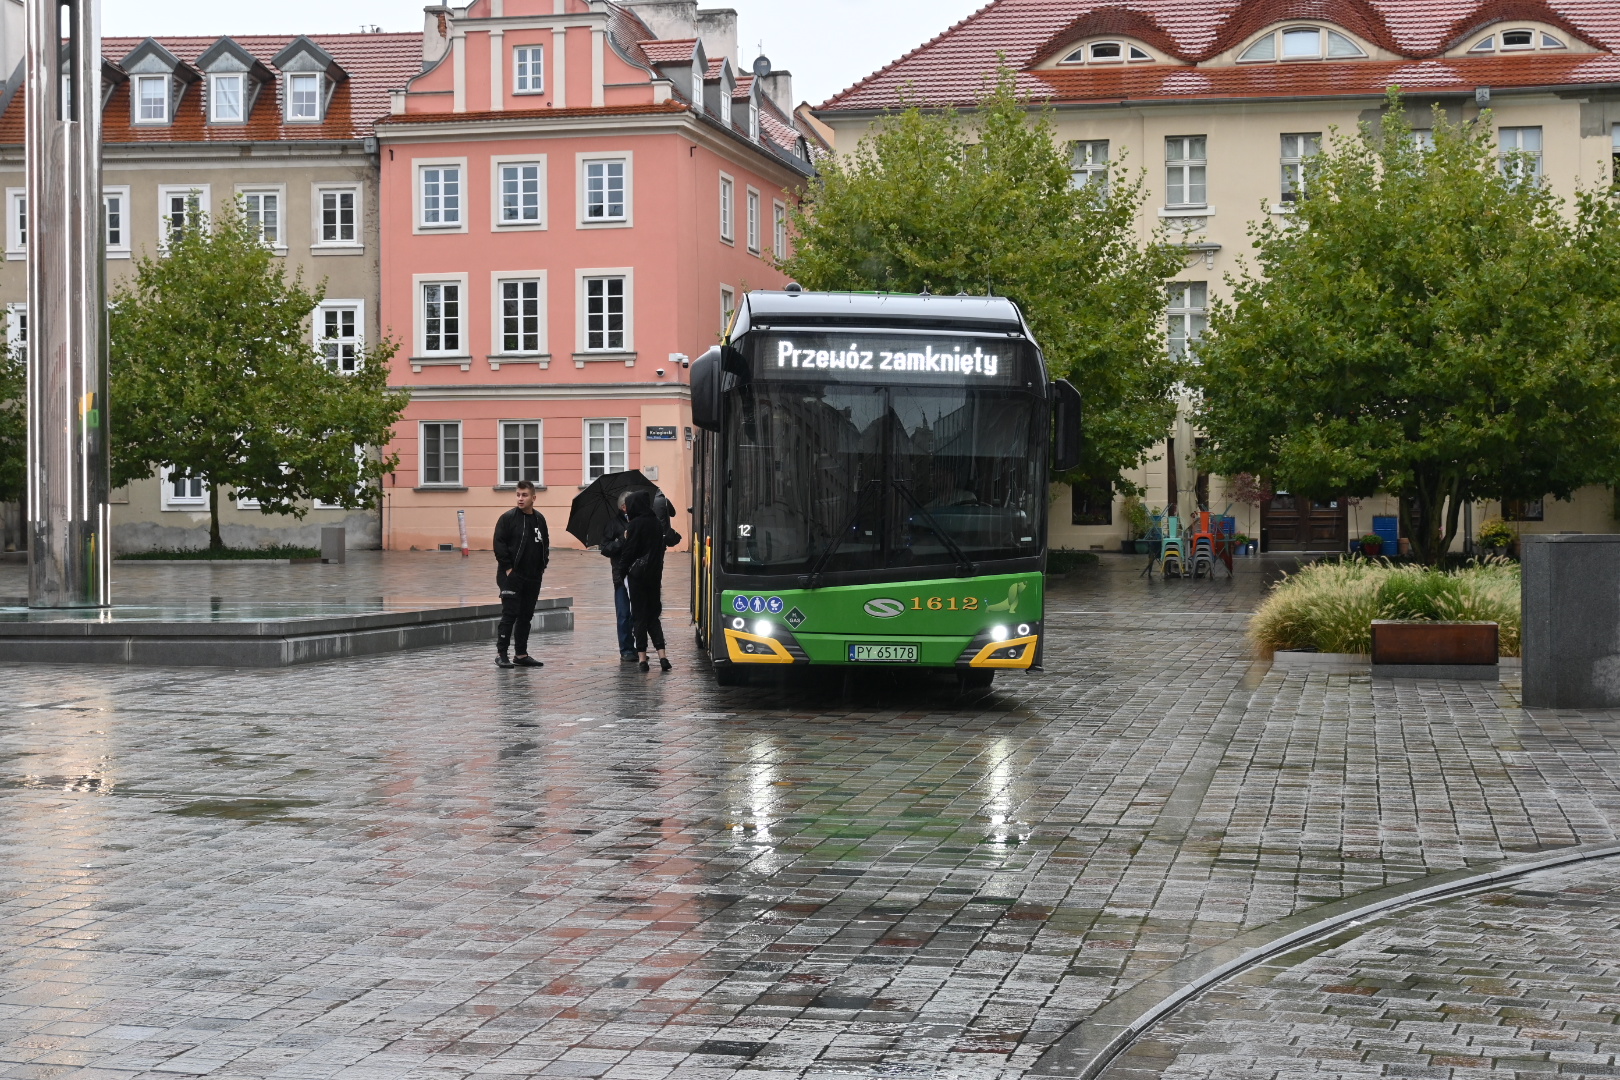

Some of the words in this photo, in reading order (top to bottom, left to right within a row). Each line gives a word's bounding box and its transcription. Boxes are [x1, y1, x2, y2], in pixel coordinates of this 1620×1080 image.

[777, 340, 873, 370] Przewóz
[879, 345, 999, 376] zamknięty
[738, 524, 751, 537] 12
[910, 596, 979, 611] 1612
[857, 646, 873, 659] PY
[877, 646, 914, 659] 65178
